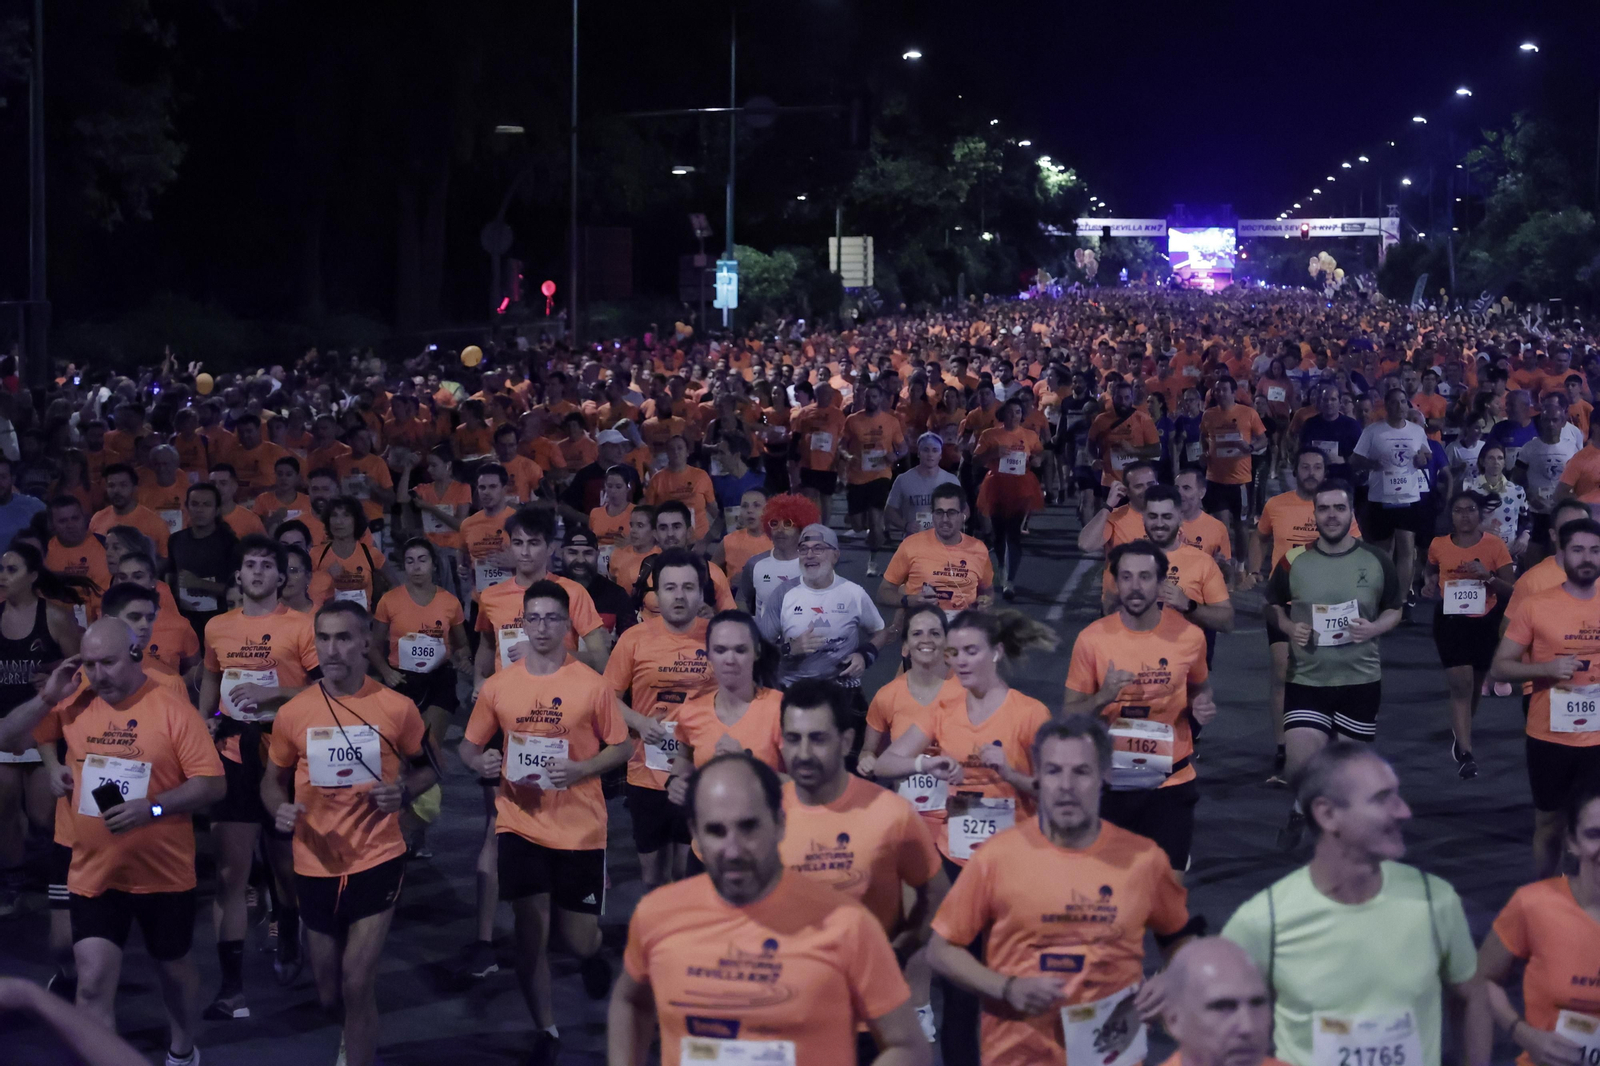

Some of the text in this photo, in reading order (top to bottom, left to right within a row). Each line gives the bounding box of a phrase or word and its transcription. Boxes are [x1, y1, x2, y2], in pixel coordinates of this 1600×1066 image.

[484, 569, 503, 578] 7556
[1453, 591, 1478, 600] 12303
[1325, 616, 1349, 629] 7768
[412, 646, 435, 657] 8368
[530, 709, 563, 717] NOCTURNA
[1566, 701, 1596, 713] 6186
[86, 736, 115, 745] SEVILLA
[1127, 738, 1158, 754] 1162
[327, 747, 363, 762] 7065
[963, 819, 997, 835] 5275
[1338, 1044, 1406, 1066] 21765
